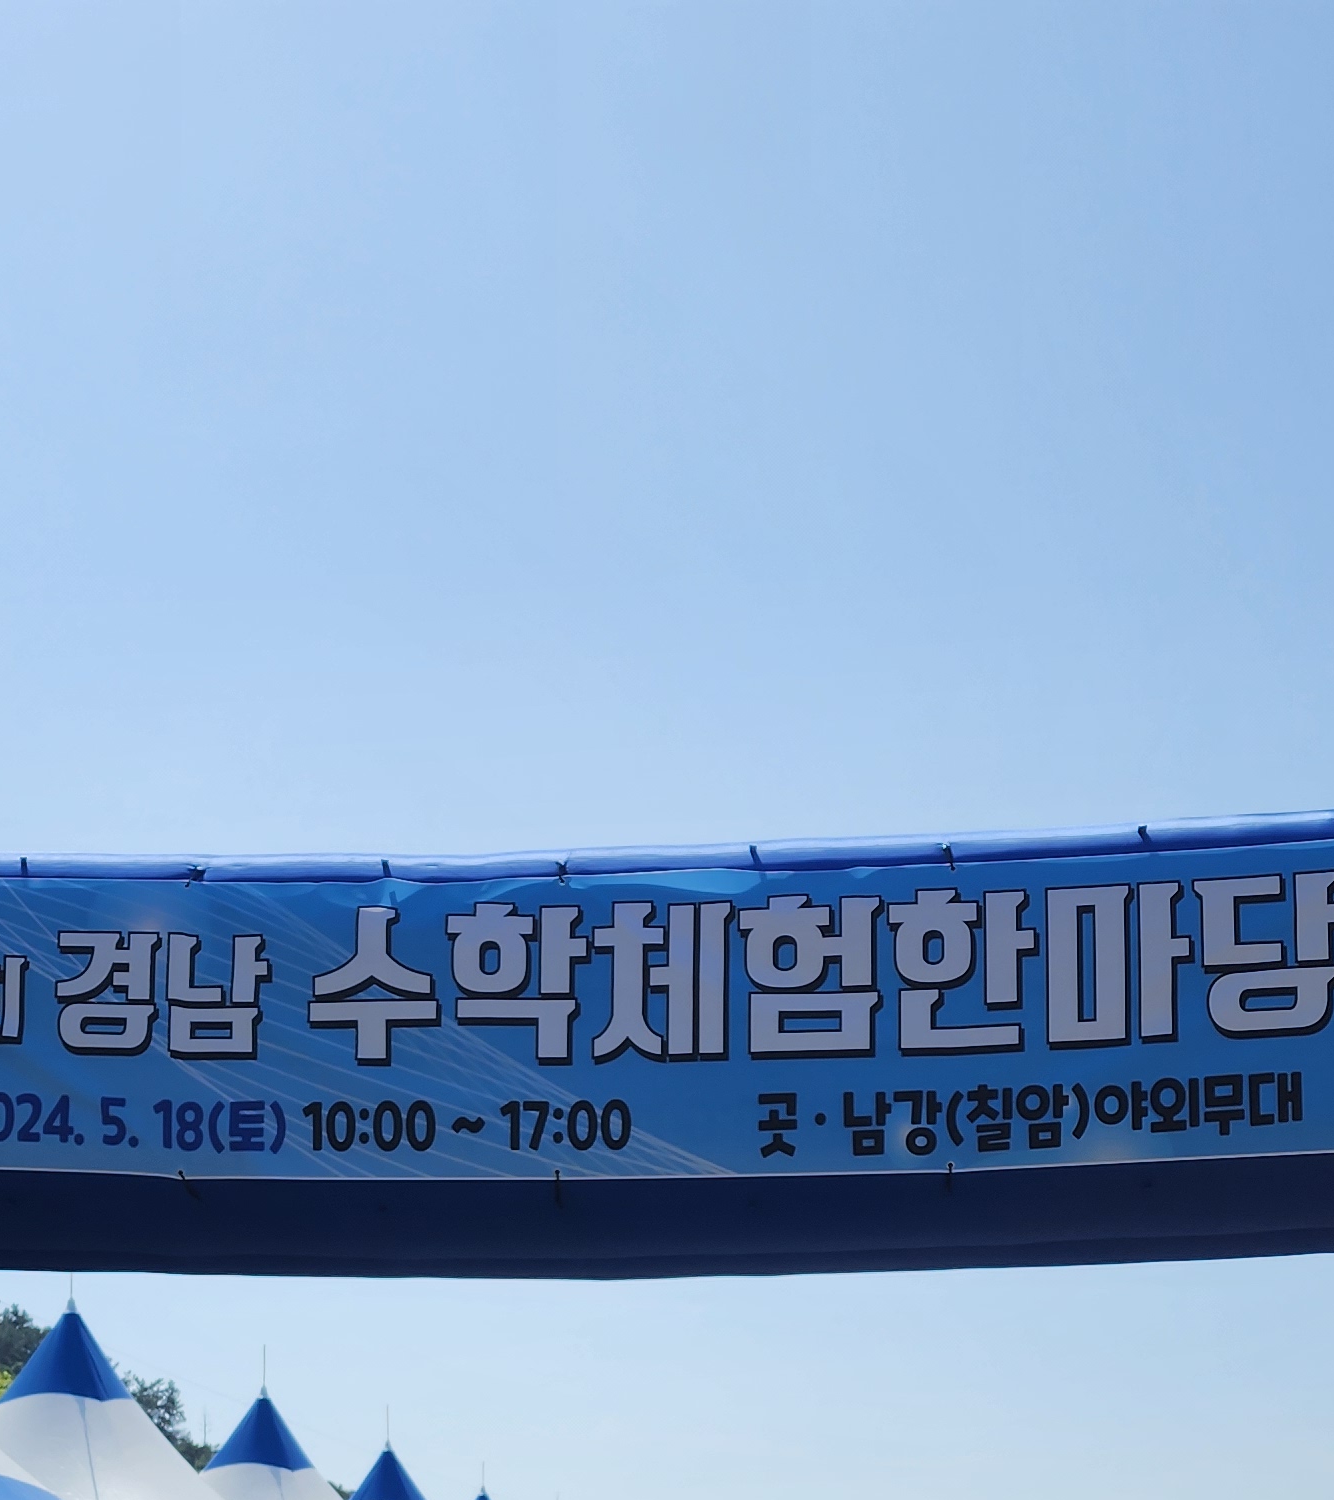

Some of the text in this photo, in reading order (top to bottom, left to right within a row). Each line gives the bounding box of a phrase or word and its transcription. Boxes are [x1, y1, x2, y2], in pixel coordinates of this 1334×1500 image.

[55, 927, 272, 1061] 경남
[100, 1094, 139, 1149] 5.
[159, 1097, 287, 1156] 18(토)
[302, 1099, 437, 1153] 10:00
[502, 1097, 633, 1152] 17:00
[842, 1071, 1305, 1158] 남강(칠암)야외무대
